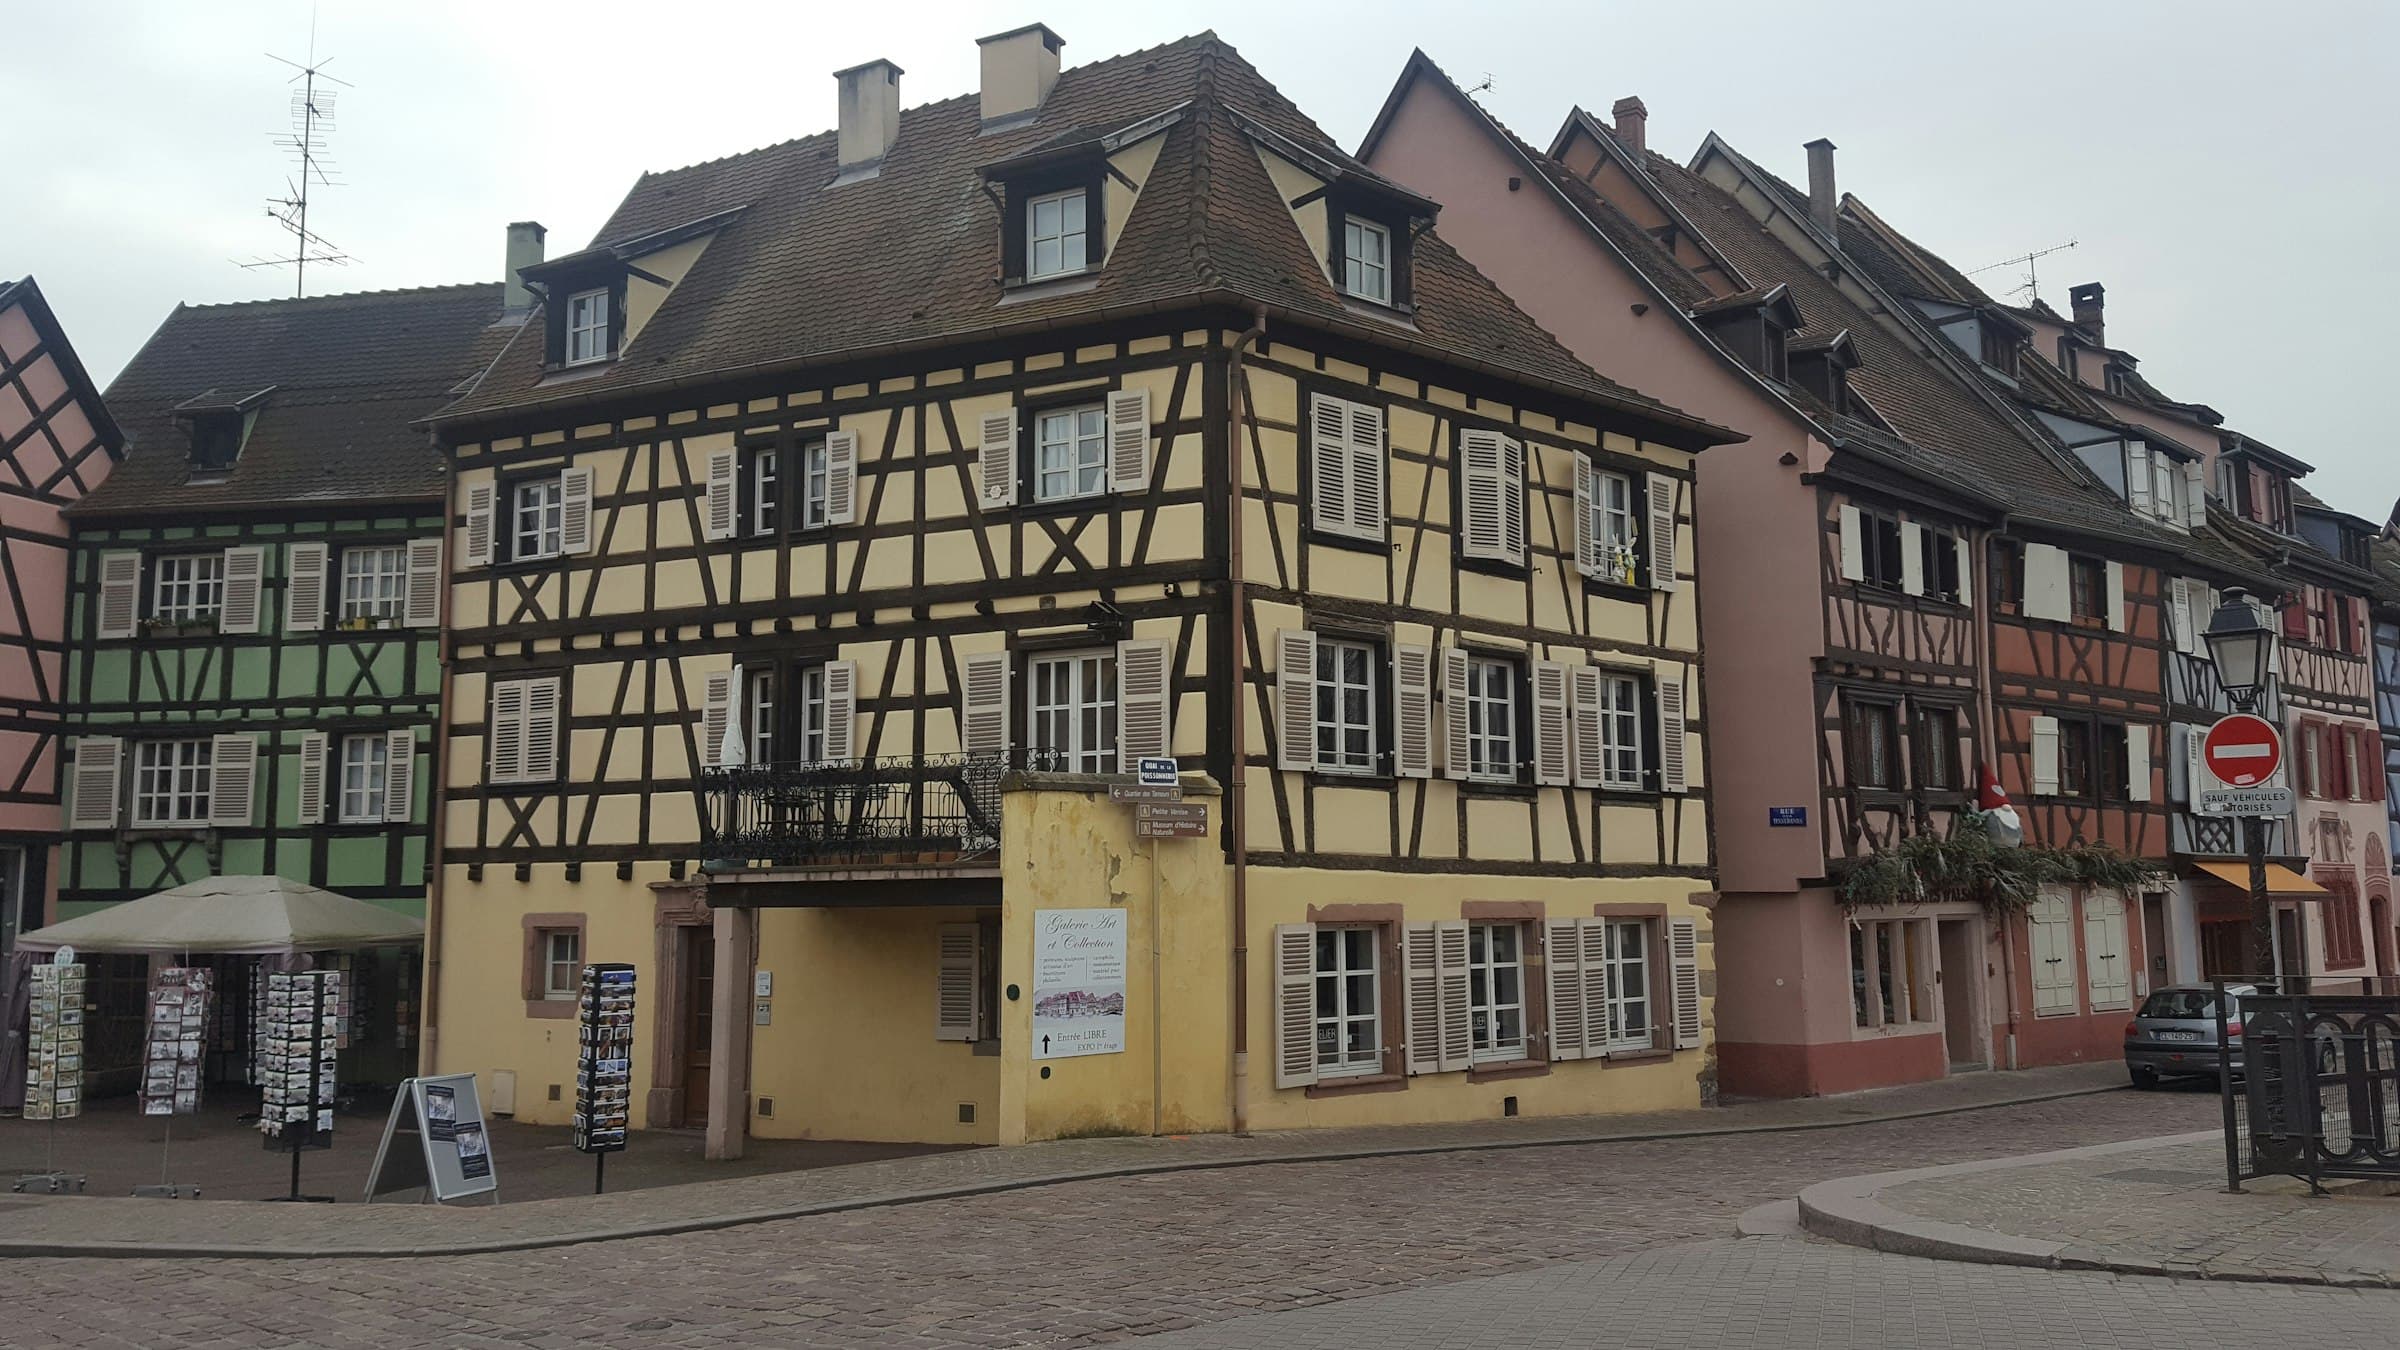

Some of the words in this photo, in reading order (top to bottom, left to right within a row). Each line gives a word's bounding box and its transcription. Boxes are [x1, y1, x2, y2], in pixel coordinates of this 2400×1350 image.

[1141, 772, 1176, 780] POISSONNERIE
[2205, 794, 2229, 803] SAUF
[1045, 912, 1088, 934] Galerie
[1091, 913, 1117, 929] Art
[1047, 940, 1057, 949] et
[1062, 934, 1113, 949] Collection
[1057, 1032, 1080, 1042] Entrée
[1083, 1029, 1107, 1040] LIBRE
